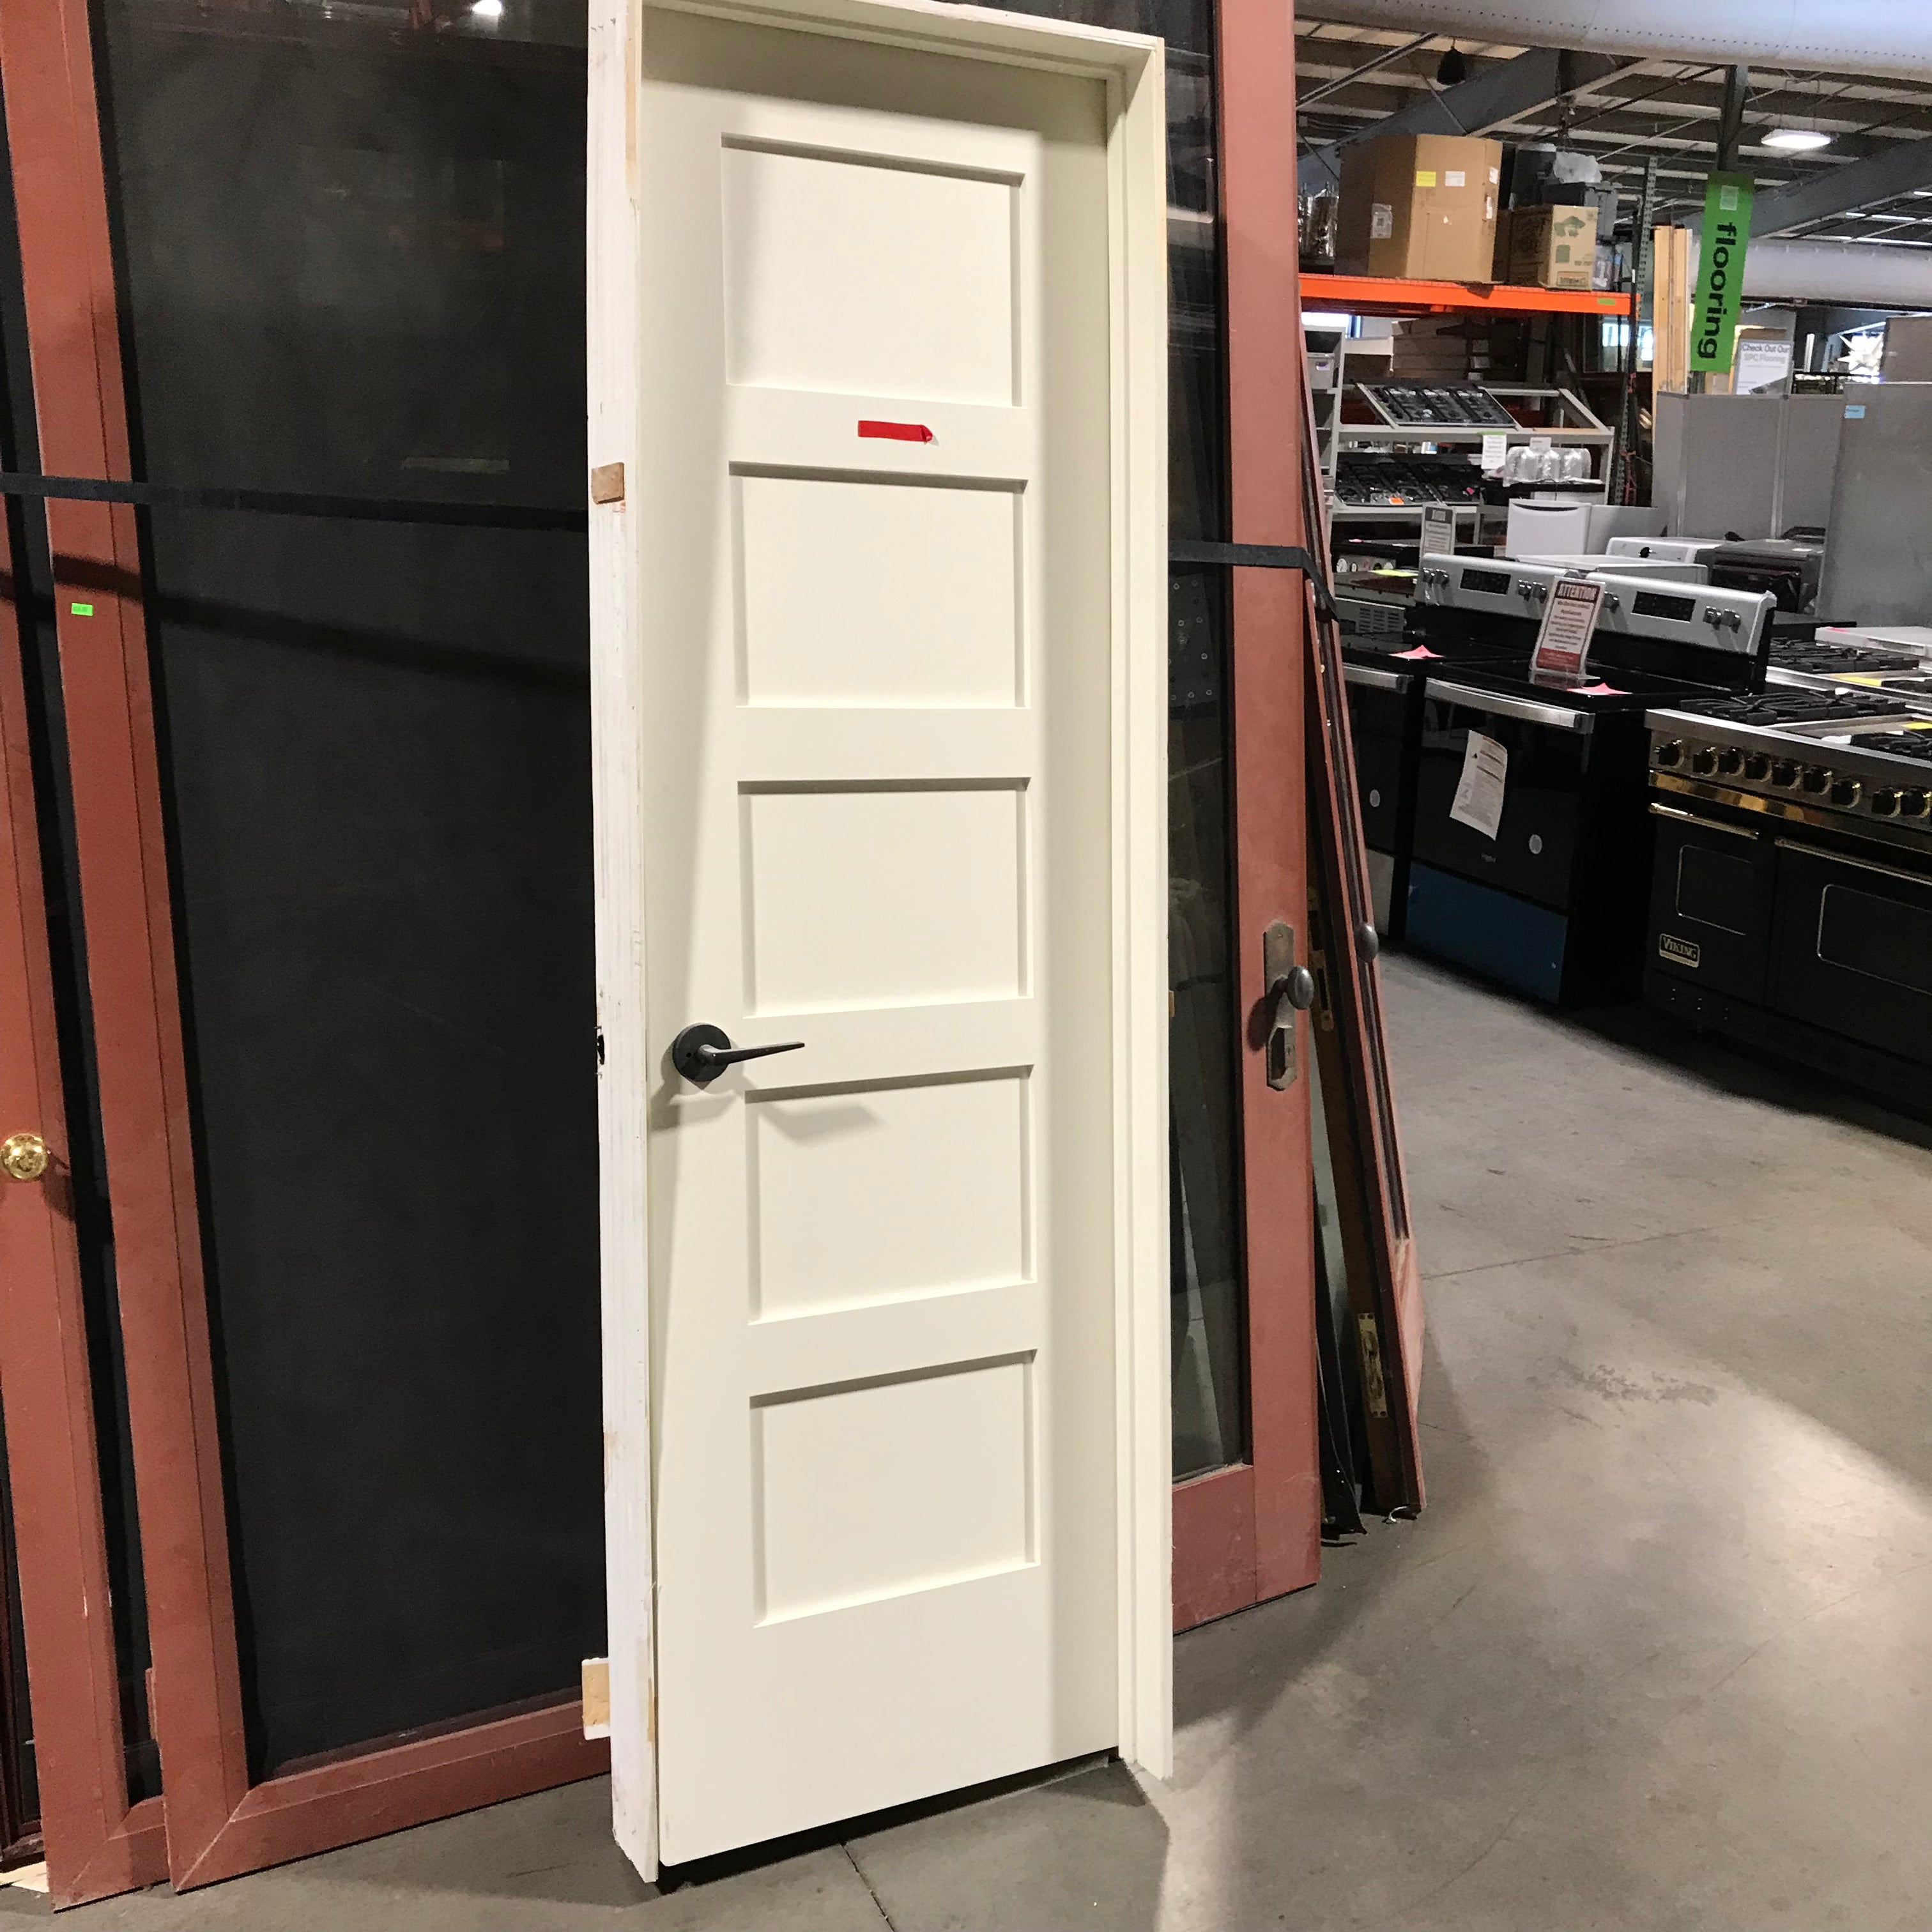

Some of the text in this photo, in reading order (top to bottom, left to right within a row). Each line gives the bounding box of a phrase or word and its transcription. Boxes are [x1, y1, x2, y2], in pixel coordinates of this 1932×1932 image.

[1697, 222, 1737, 359] flooring
[1742, 343, 1762, 351] Check
[1663, 937, 1696, 958] VIKING
